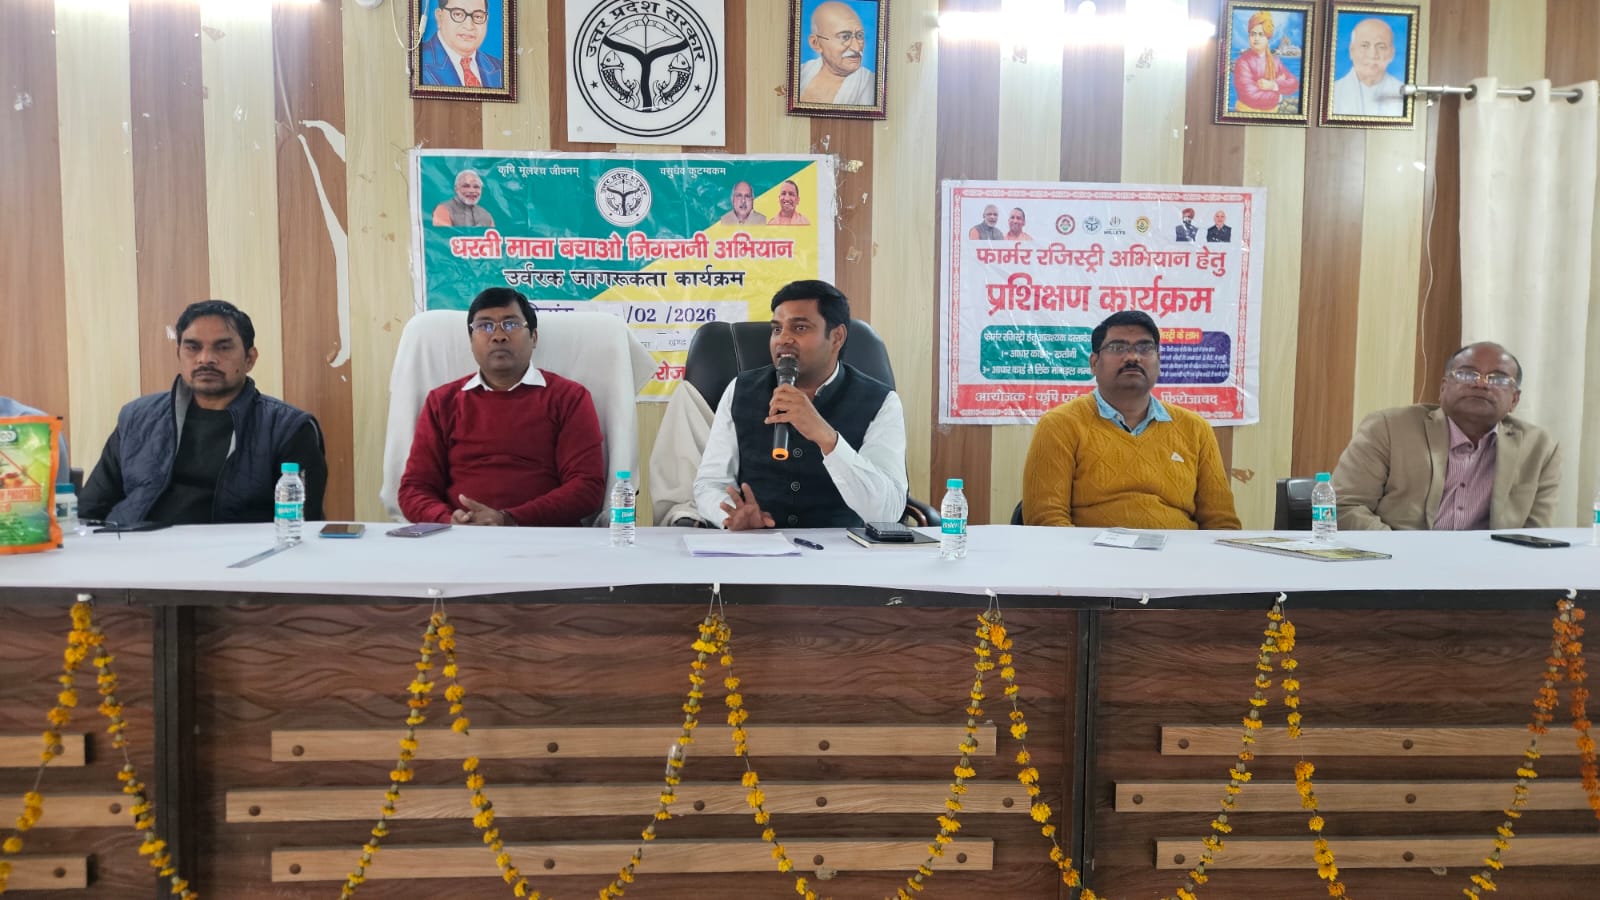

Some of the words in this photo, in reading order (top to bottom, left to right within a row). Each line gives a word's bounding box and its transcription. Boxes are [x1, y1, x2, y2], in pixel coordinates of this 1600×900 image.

[586, 18, 611, 57] उत्तर
[666, 7, 706, 62] सरकार
[451, 230, 501, 258] धरती
[506, 237, 556, 258] माता
[559, 233, 623, 259] बचाओ
[627, 231, 709, 260] निगरानी
[713, 232, 795, 260] अभियान
[976, 242, 1033, 265] फार्मर
[1036, 242, 1104, 273] रजिस्ट्री
[1109, 244, 1191, 267] अभियान
[1196, 245, 1227, 277] हेतु
[503, 263, 565, 288] उर्वरक
[570, 270, 667, 288] जागरूकता
[674, 264, 745, 288] कार्यक्रम
[986, 272, 1092, 316] प्रशिक्षण
[1099, 275, 1215, 318] कार्यक्रम
